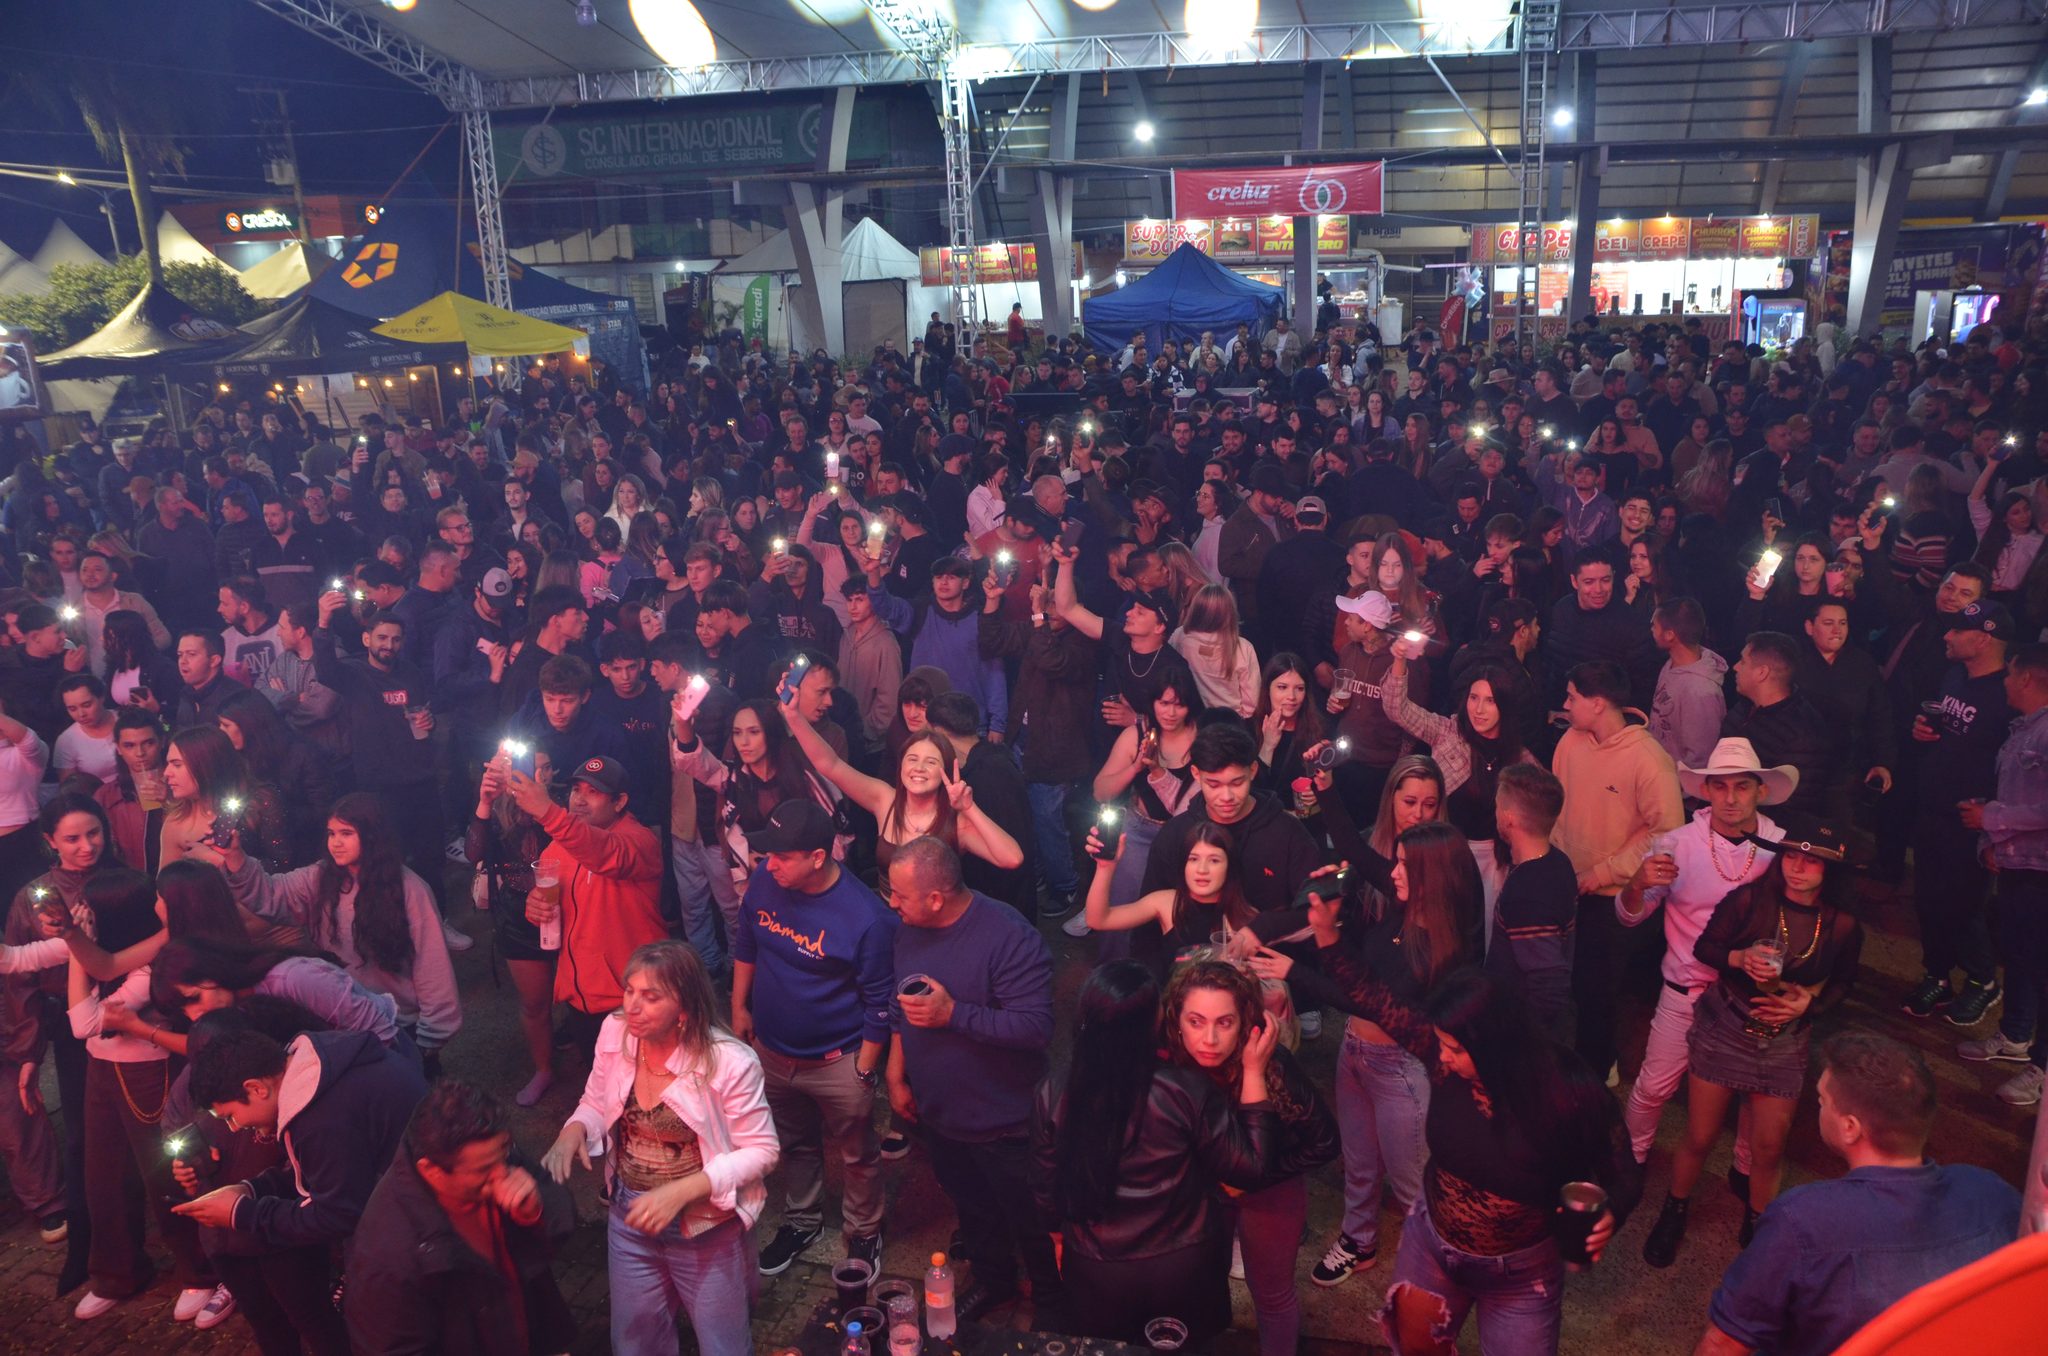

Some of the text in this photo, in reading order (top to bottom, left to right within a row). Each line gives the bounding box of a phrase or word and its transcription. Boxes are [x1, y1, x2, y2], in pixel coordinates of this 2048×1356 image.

[578, 116, 783, 156] SC INTERNACIONAL
[584, 155, 649, 170] CONSULADO
[654, 153, 697, 165] OFICIAL
[702, 151, 718, 163] DE
[1207, 180, 1272, 202] creluz
[1132, 224, 1187, 242] SUPER
[1222, 222, 1252, 232] XIS
[1692, 226, 1737, 238] CHURROS
[1743, 225, 1788, 237] CHURROS
[1598, 236, 1629, 252] REI
[1642, 234, 1688, 250] CREPE
[578, 302, 596, 312] TOTAL
[614, 300, 629, 309] STAR
[752, 287, 763, 330] Sicredi
[607, 319, 622, 330] STAR
[1941, 694, 1977, 723] KING
[757, 910, 825, 957] Diamond
